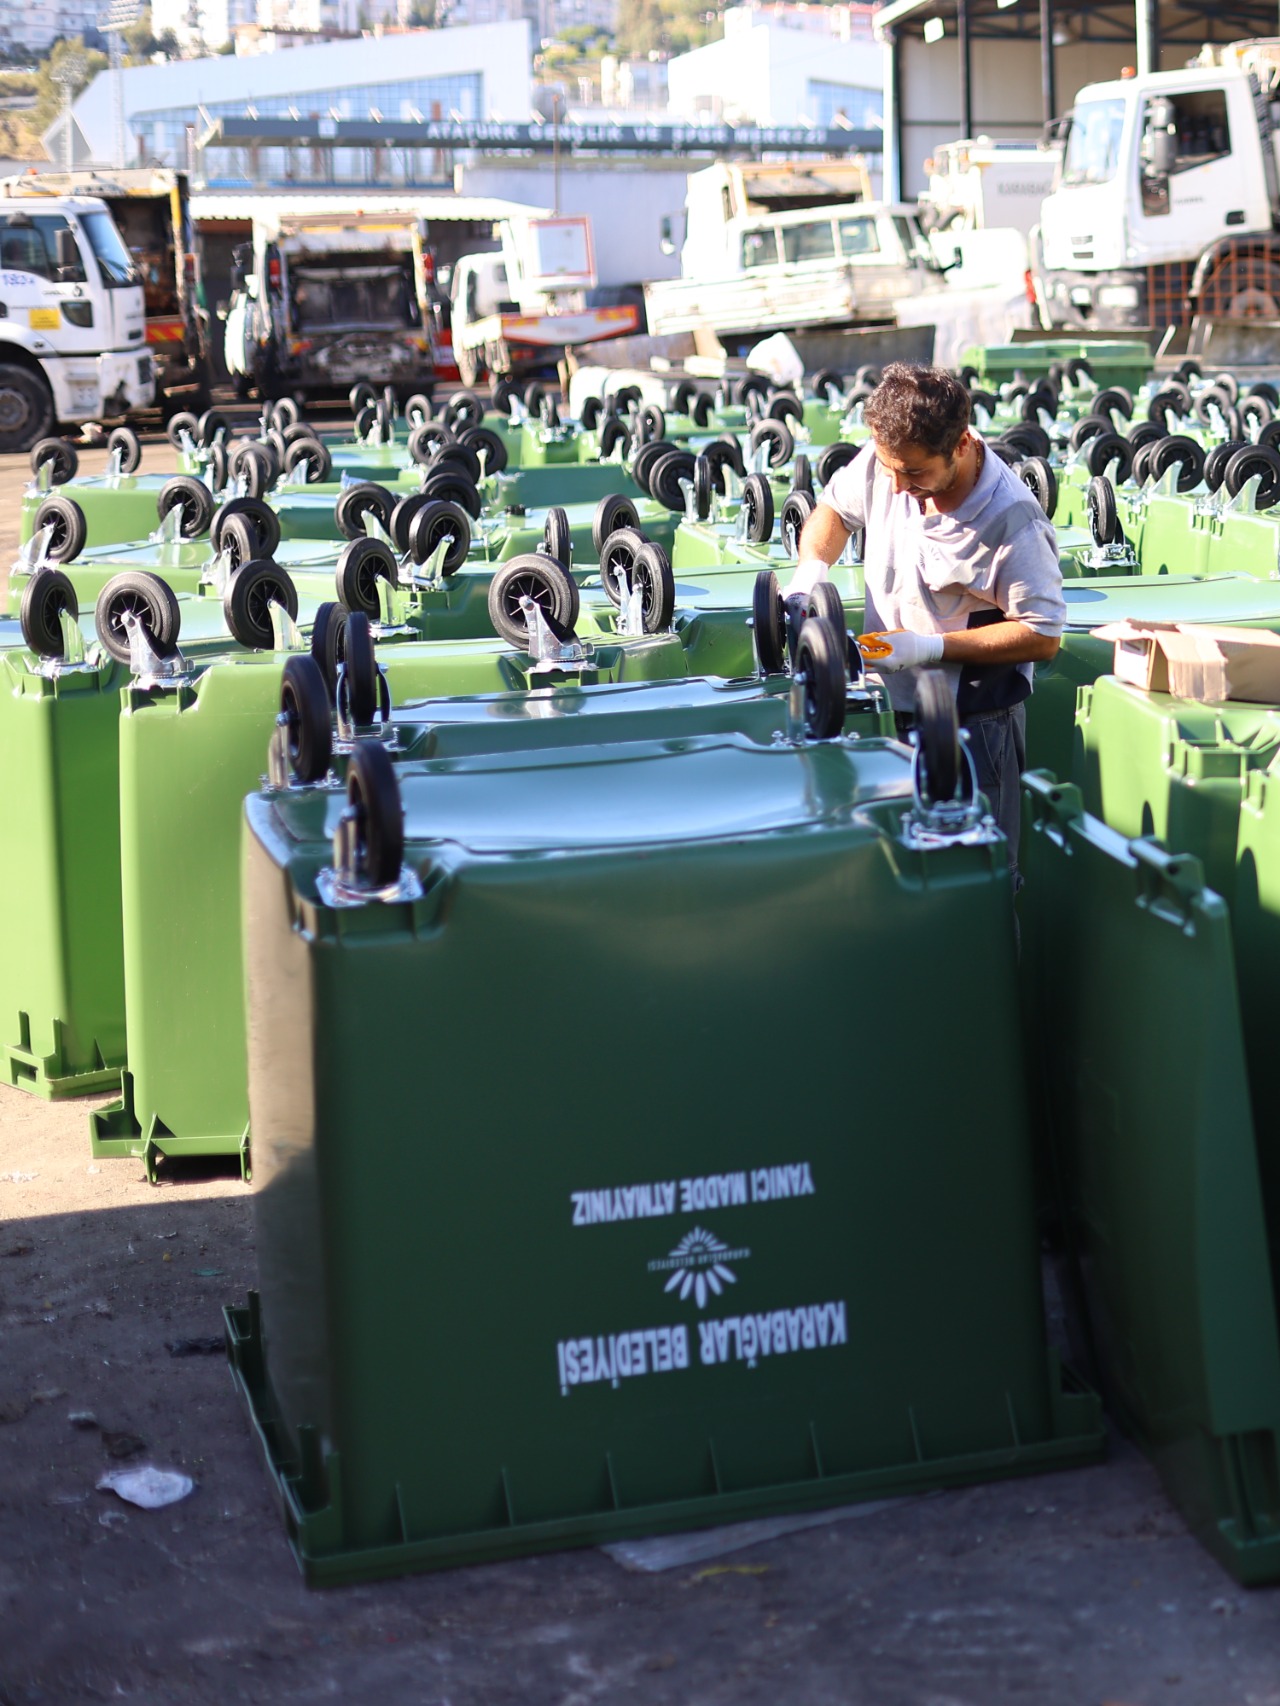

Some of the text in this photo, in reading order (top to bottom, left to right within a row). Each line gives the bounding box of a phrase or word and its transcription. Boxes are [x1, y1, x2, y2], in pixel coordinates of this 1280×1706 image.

[570, 1161, 815, 1226] YANICI MADDE ATMAYINIZ
[557, 1299, 847, 1397] KARABAĞLAR BELEDİYESİ
